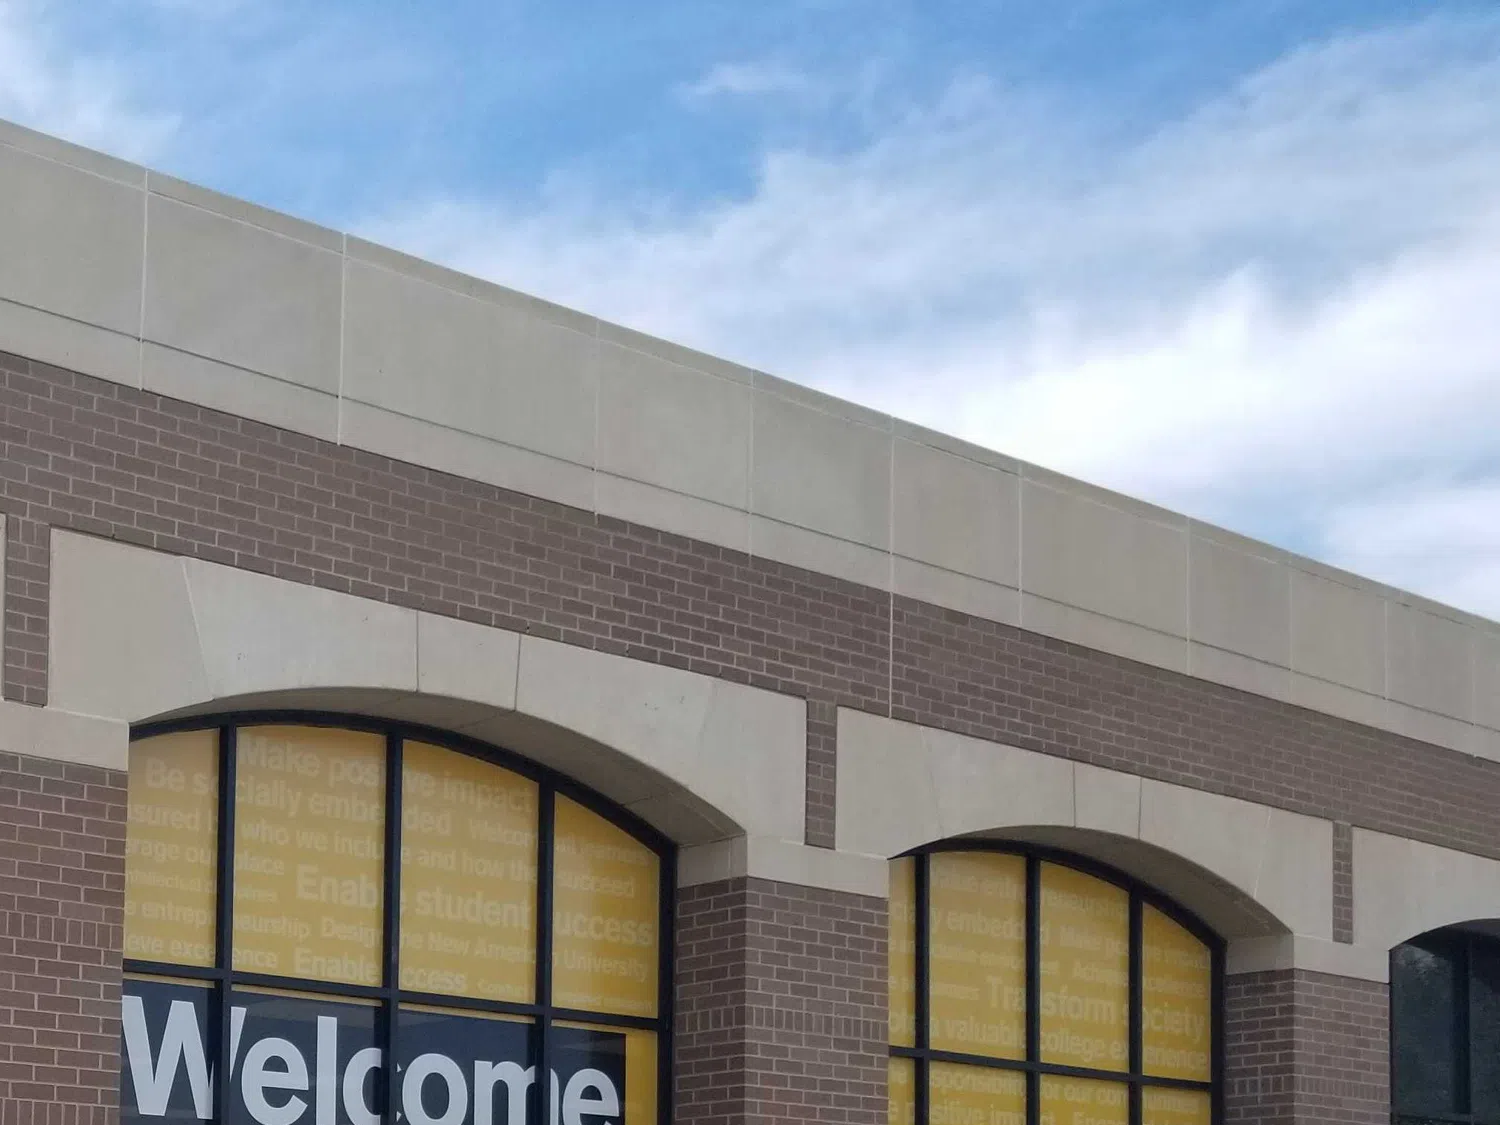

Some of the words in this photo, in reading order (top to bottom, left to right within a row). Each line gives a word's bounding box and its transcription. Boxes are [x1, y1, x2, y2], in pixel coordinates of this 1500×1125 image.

[147, 757, 186, 793] Be
[241, 818, 290, 846] who
[295, 829, 329, 850] we
[415, 849, 457, 872] and
[462, 852, 505, 878] how
[414, 884, 531, 929] student
[294, 946, 378, 984] Enable
